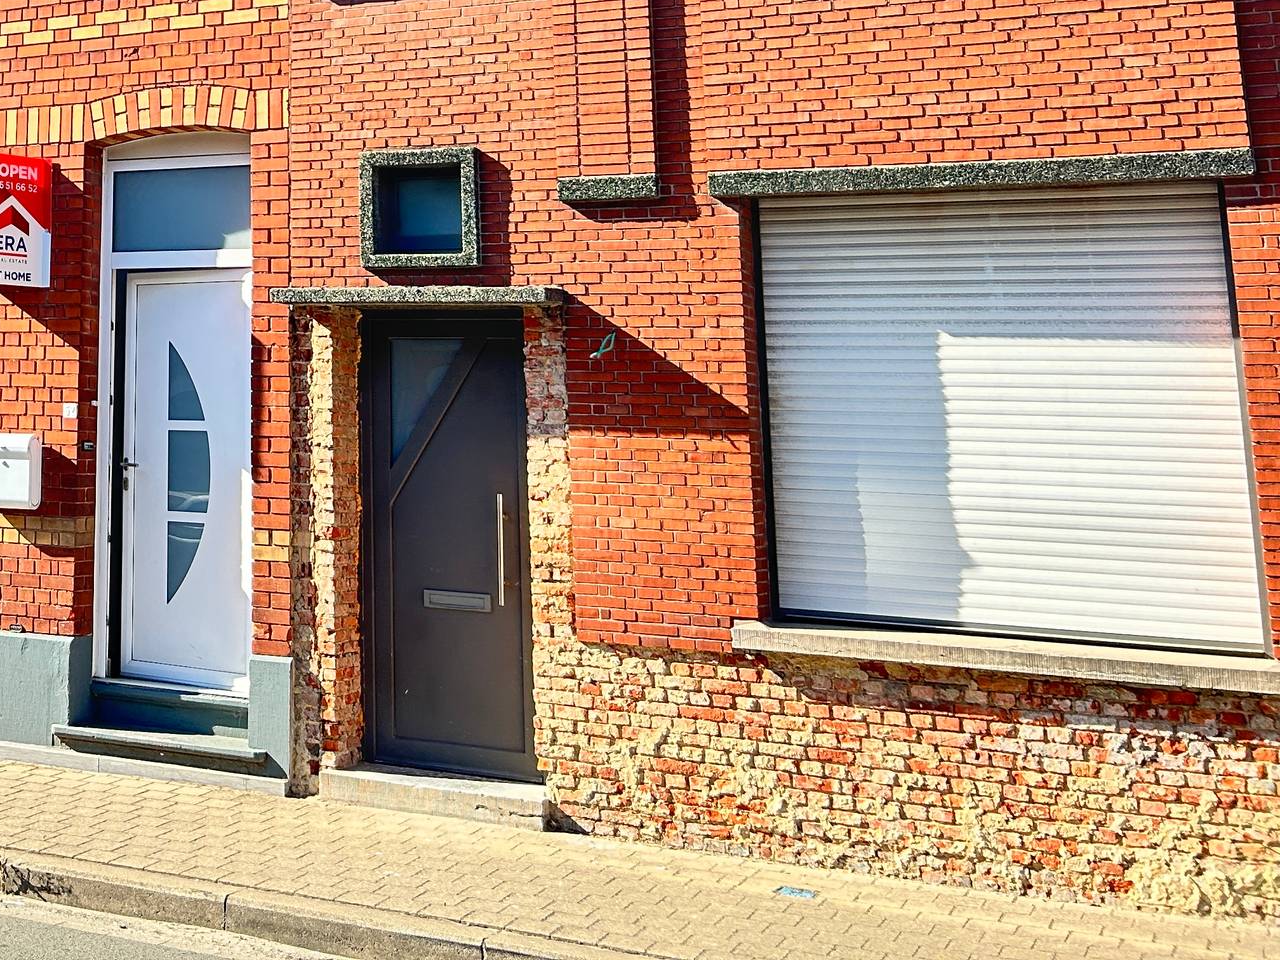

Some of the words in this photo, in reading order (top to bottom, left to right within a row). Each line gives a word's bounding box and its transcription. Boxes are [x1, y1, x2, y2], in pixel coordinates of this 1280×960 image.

[5, 181, 13, 190] 51
[15, 182, 26, 192] 66
[28, 183, 38, 193] 52
[4, 271, 32, 282] HOME
